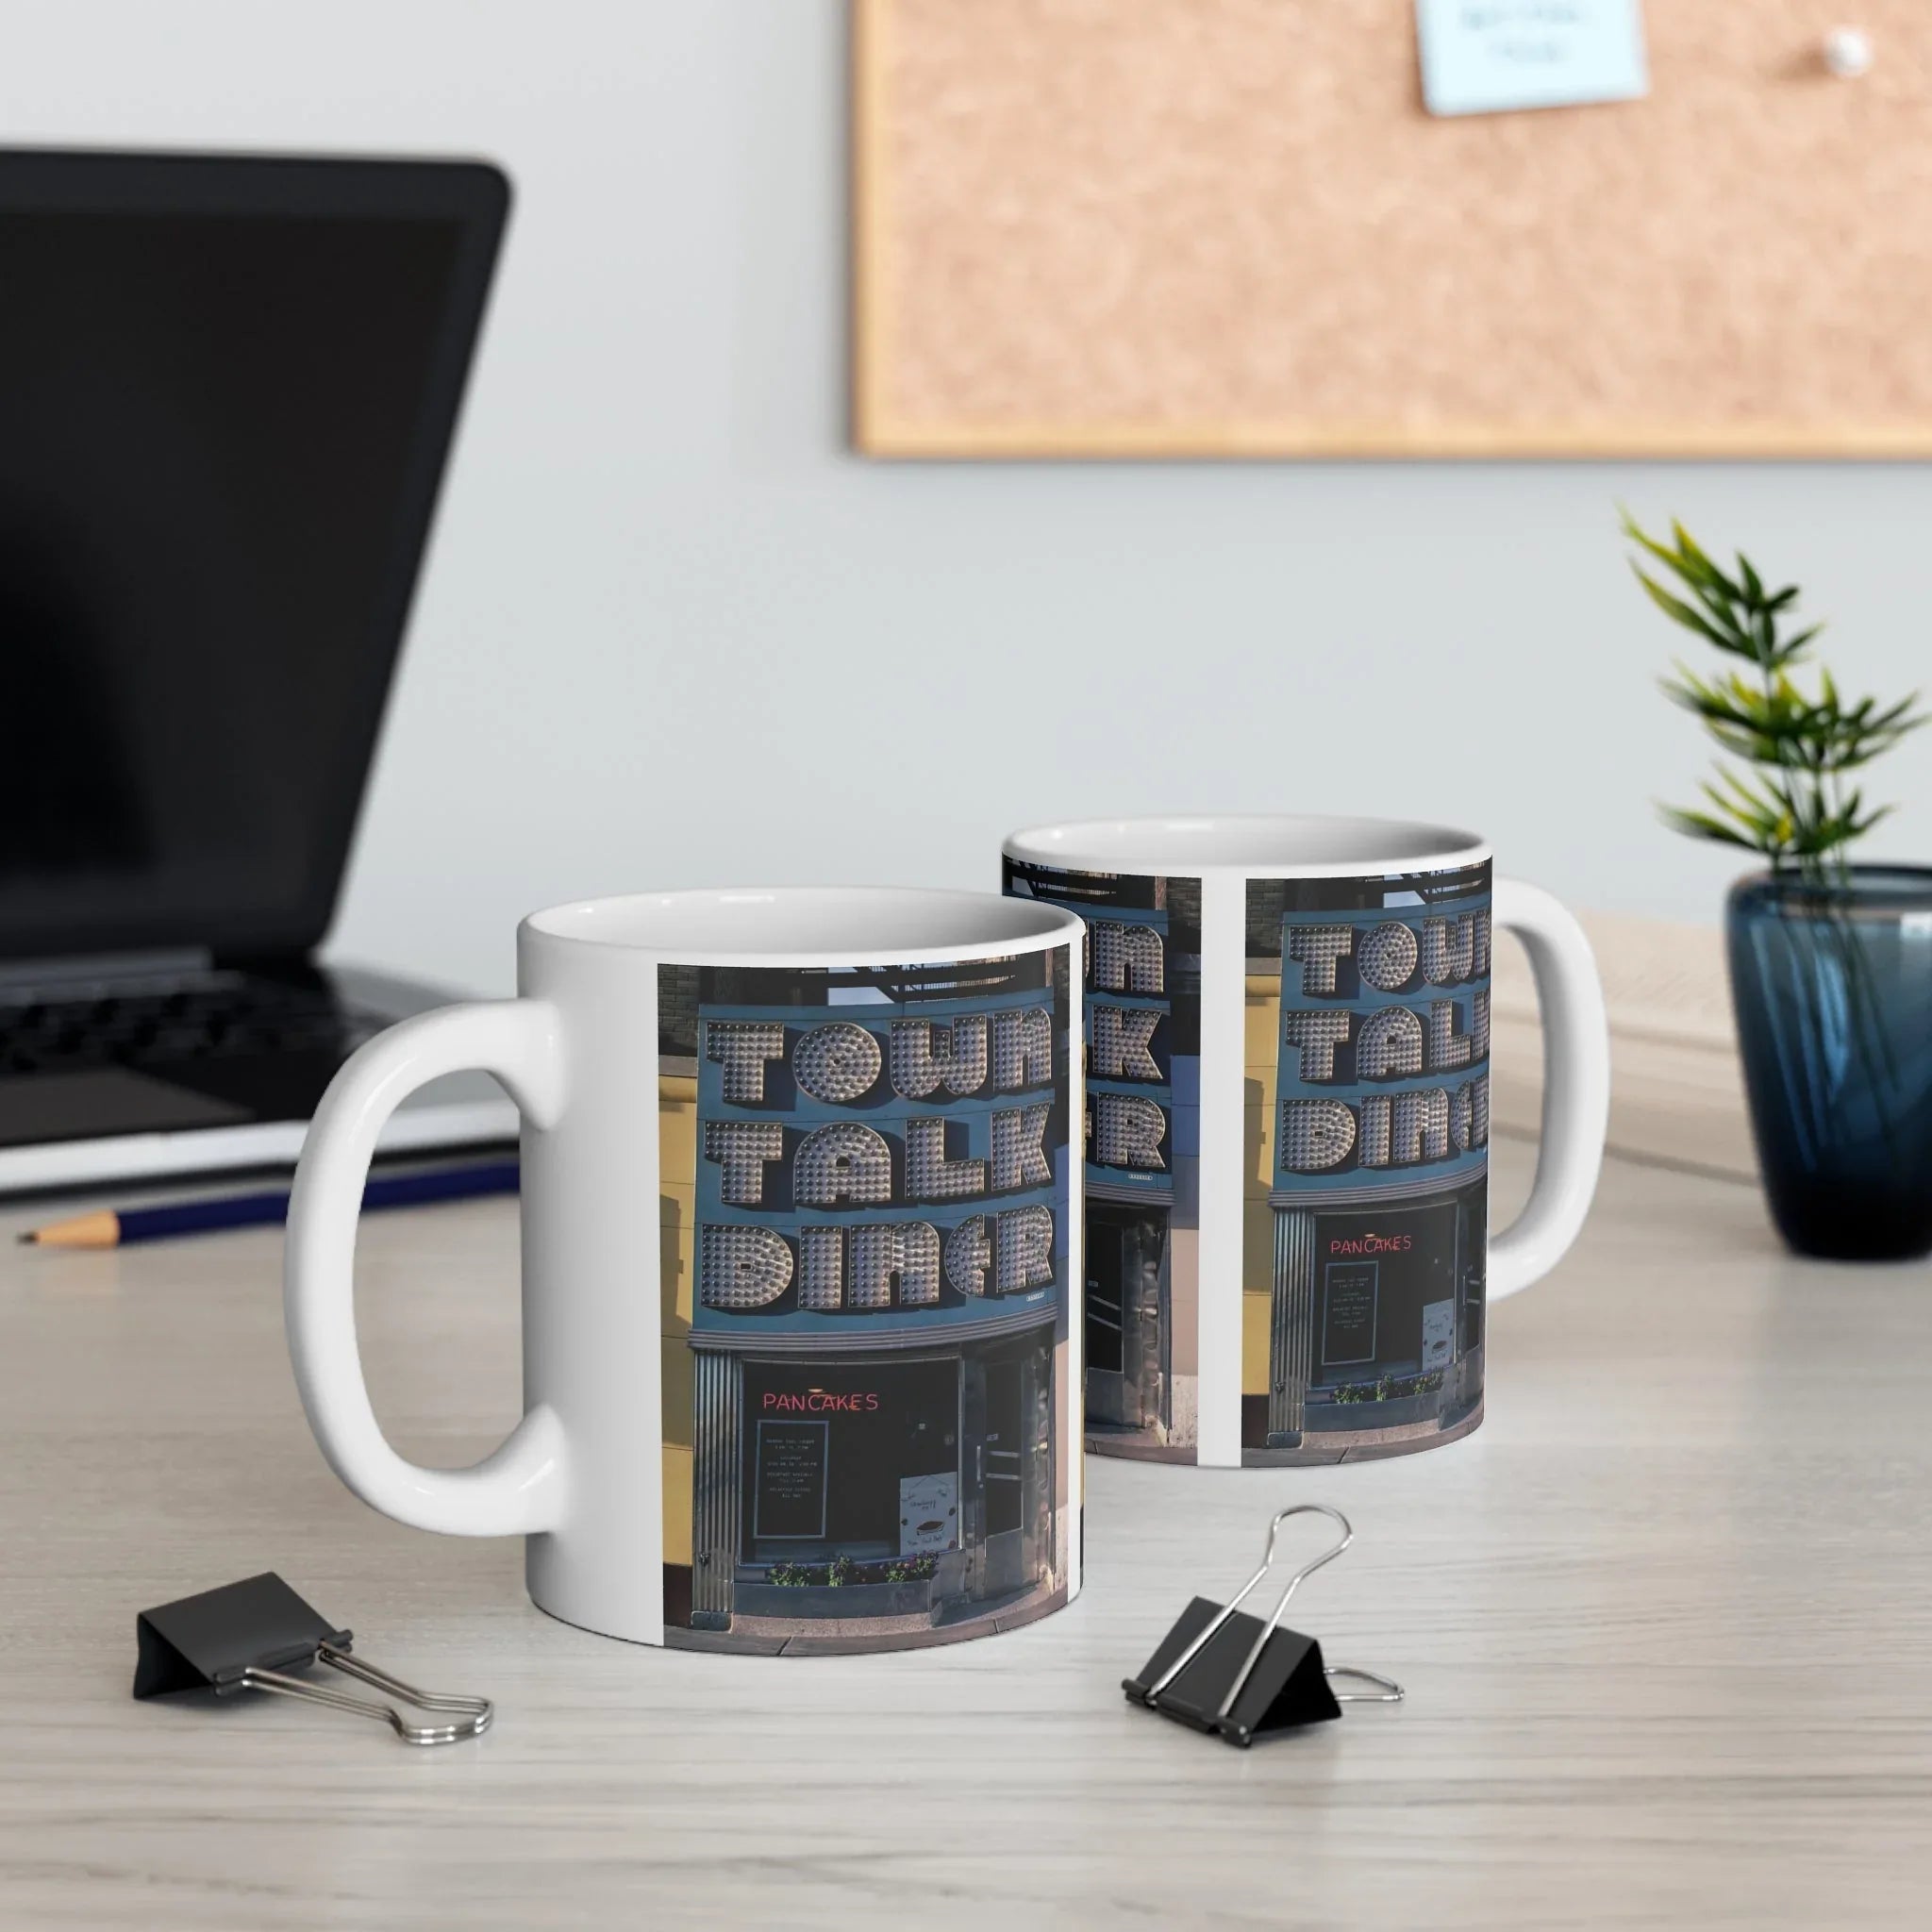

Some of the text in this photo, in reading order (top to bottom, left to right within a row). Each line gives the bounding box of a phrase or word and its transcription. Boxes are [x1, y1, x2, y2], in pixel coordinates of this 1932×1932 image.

[706, 1008, 1052, 1103] TOWN
[705, 1102, 1052, 1204] TALK
[701, 1204, 1053, 1309] DINER
[1330, 1235, 1411, 1255] PANCAKES
[763, 1392, 878, 1411] PANCAKES
